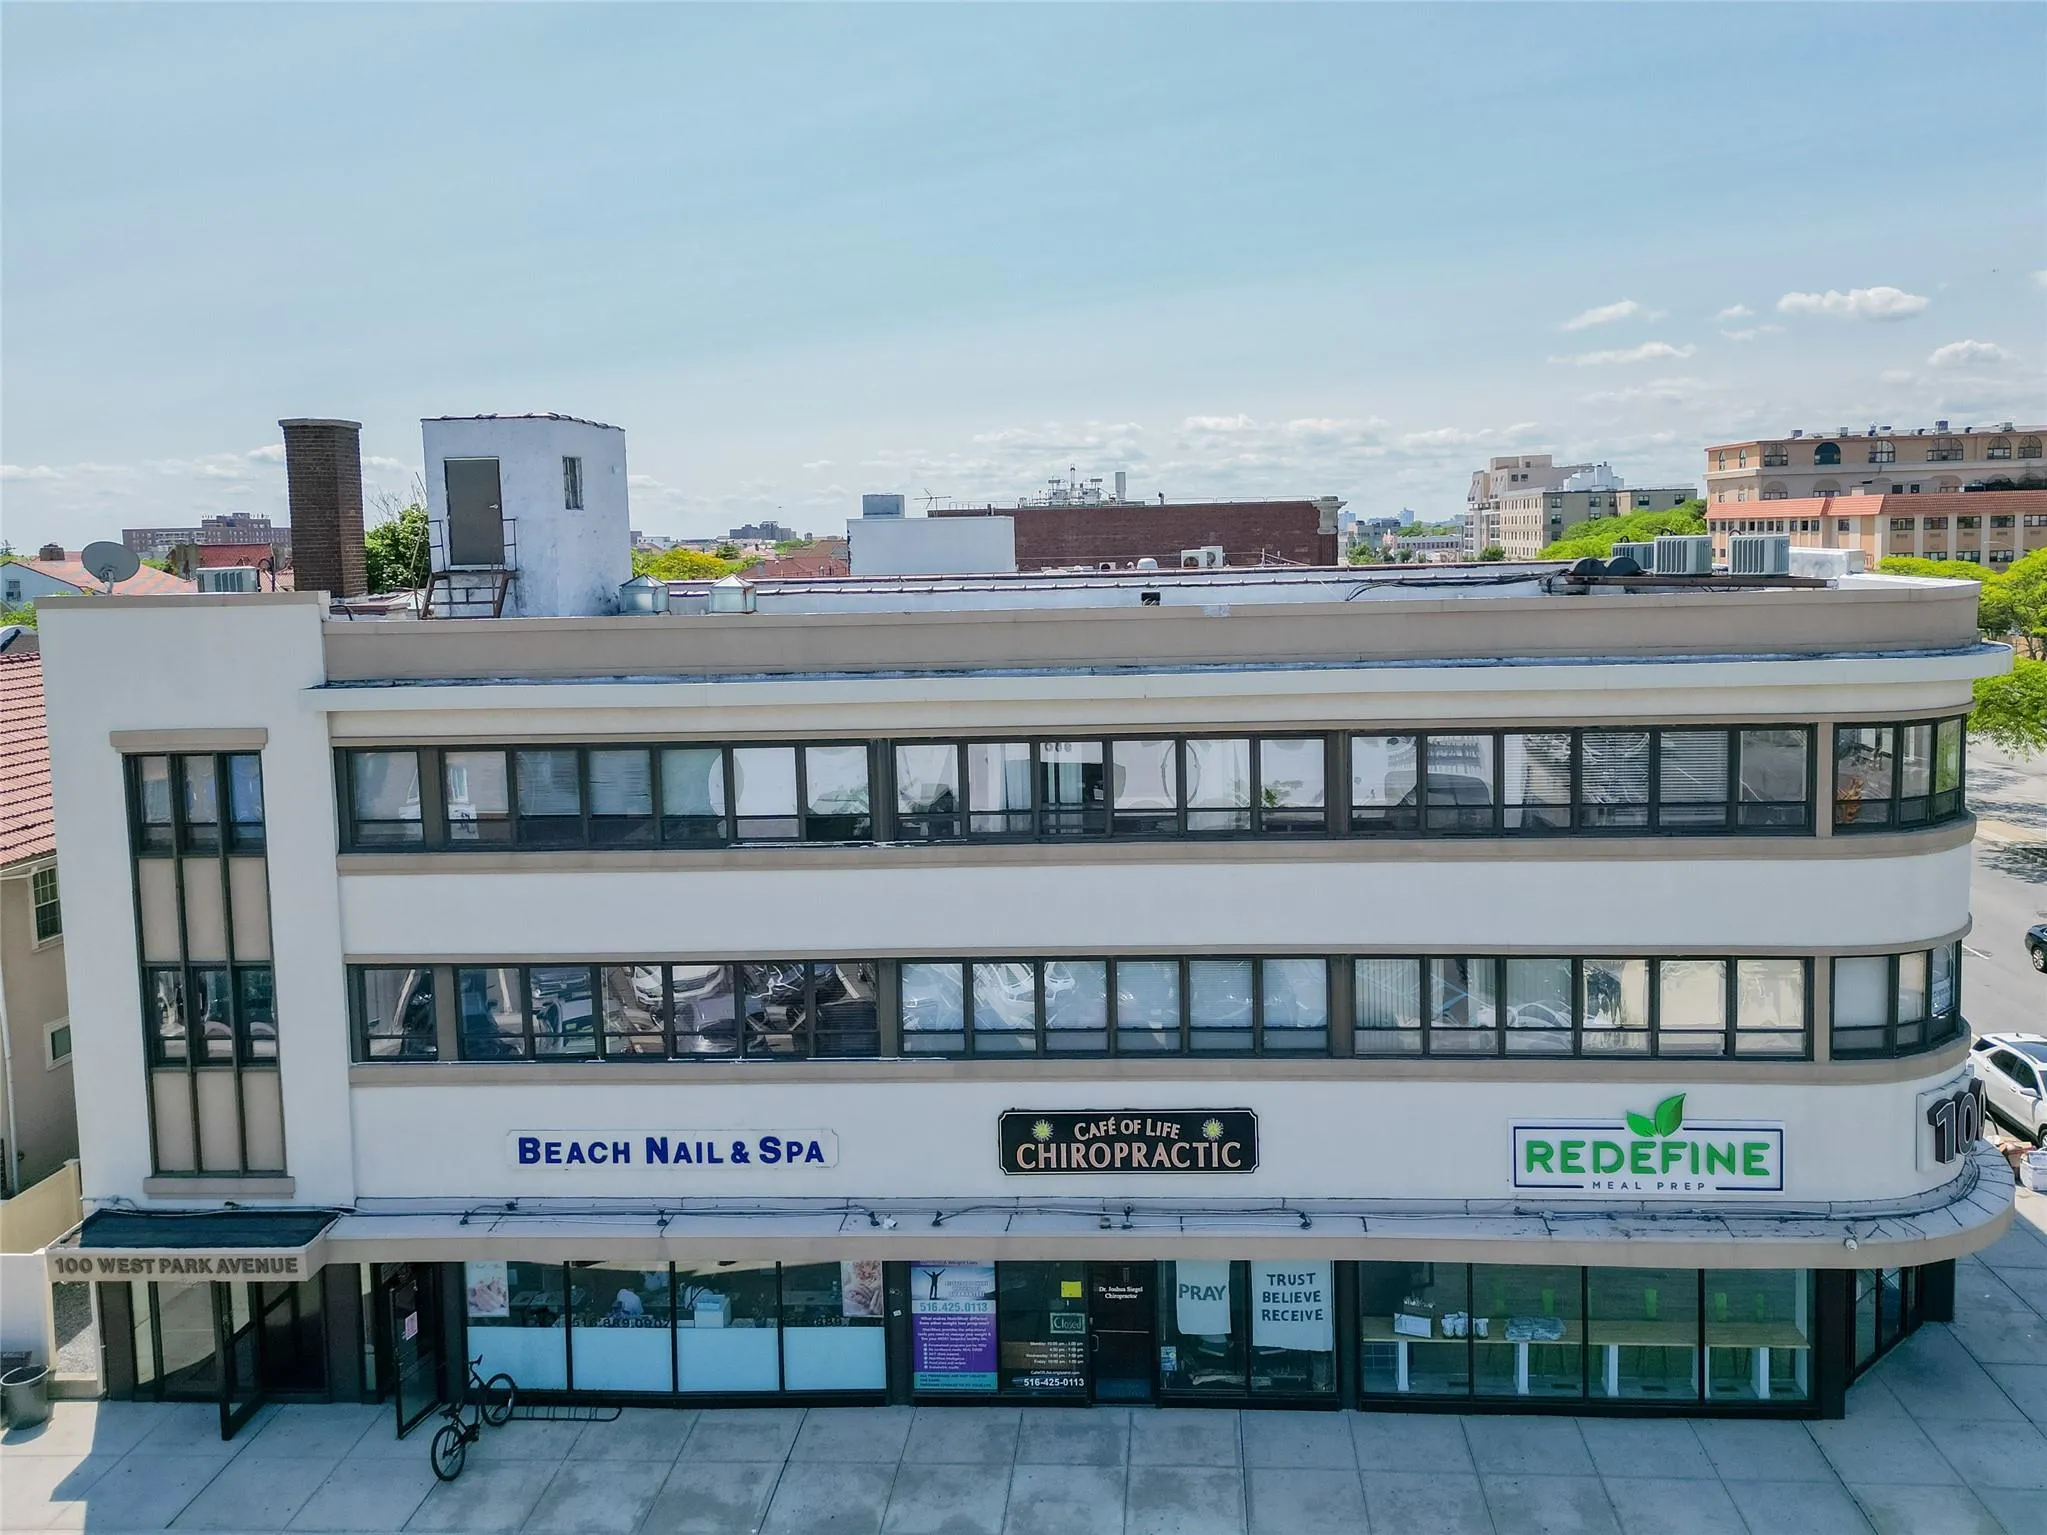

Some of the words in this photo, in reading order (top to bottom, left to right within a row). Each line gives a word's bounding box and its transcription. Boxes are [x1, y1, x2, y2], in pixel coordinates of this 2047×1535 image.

[1074, 1116, 1117, 1141] CAFÉ
[1120, 1119, 1142, 1135] OF
[1145, 1118, 1181, 1140] LIFE
[518, 1136, 631, 1164] BEACH
[645, 1136, 724, 1164] NAIL
[759, 1136, 825, 1164] SPA
[1016, 1141, 1241, 1169] CHIROPRACTIC
[1525, 1140, 1771, 1176] REDEFINE
[1592, 1181, 1643, 1190] MEAL
[1657, 1182, 1705, 1191] PREP
[55, 1258, 93, 1274] 100
[97, 1258, 156, 1274] WEST
[159, 1258, 212, 1274] PARK
[217, 1257, 298, 1274] AVENUE
[1267, 1273, 1316, 1286] TRUST
[1179, 1284, 1226, 1301] PRAY
[1262, 1290, 1322, 1304] BELIEVE
[920, 1302, 988, 1313] 516.425.0113
[1261, 1308, 1324, 1322] RECEIVE
[1053, 1317, 1082, 1329] Closed
[1024, 1378, 1085, 1387] 516-425-0113
